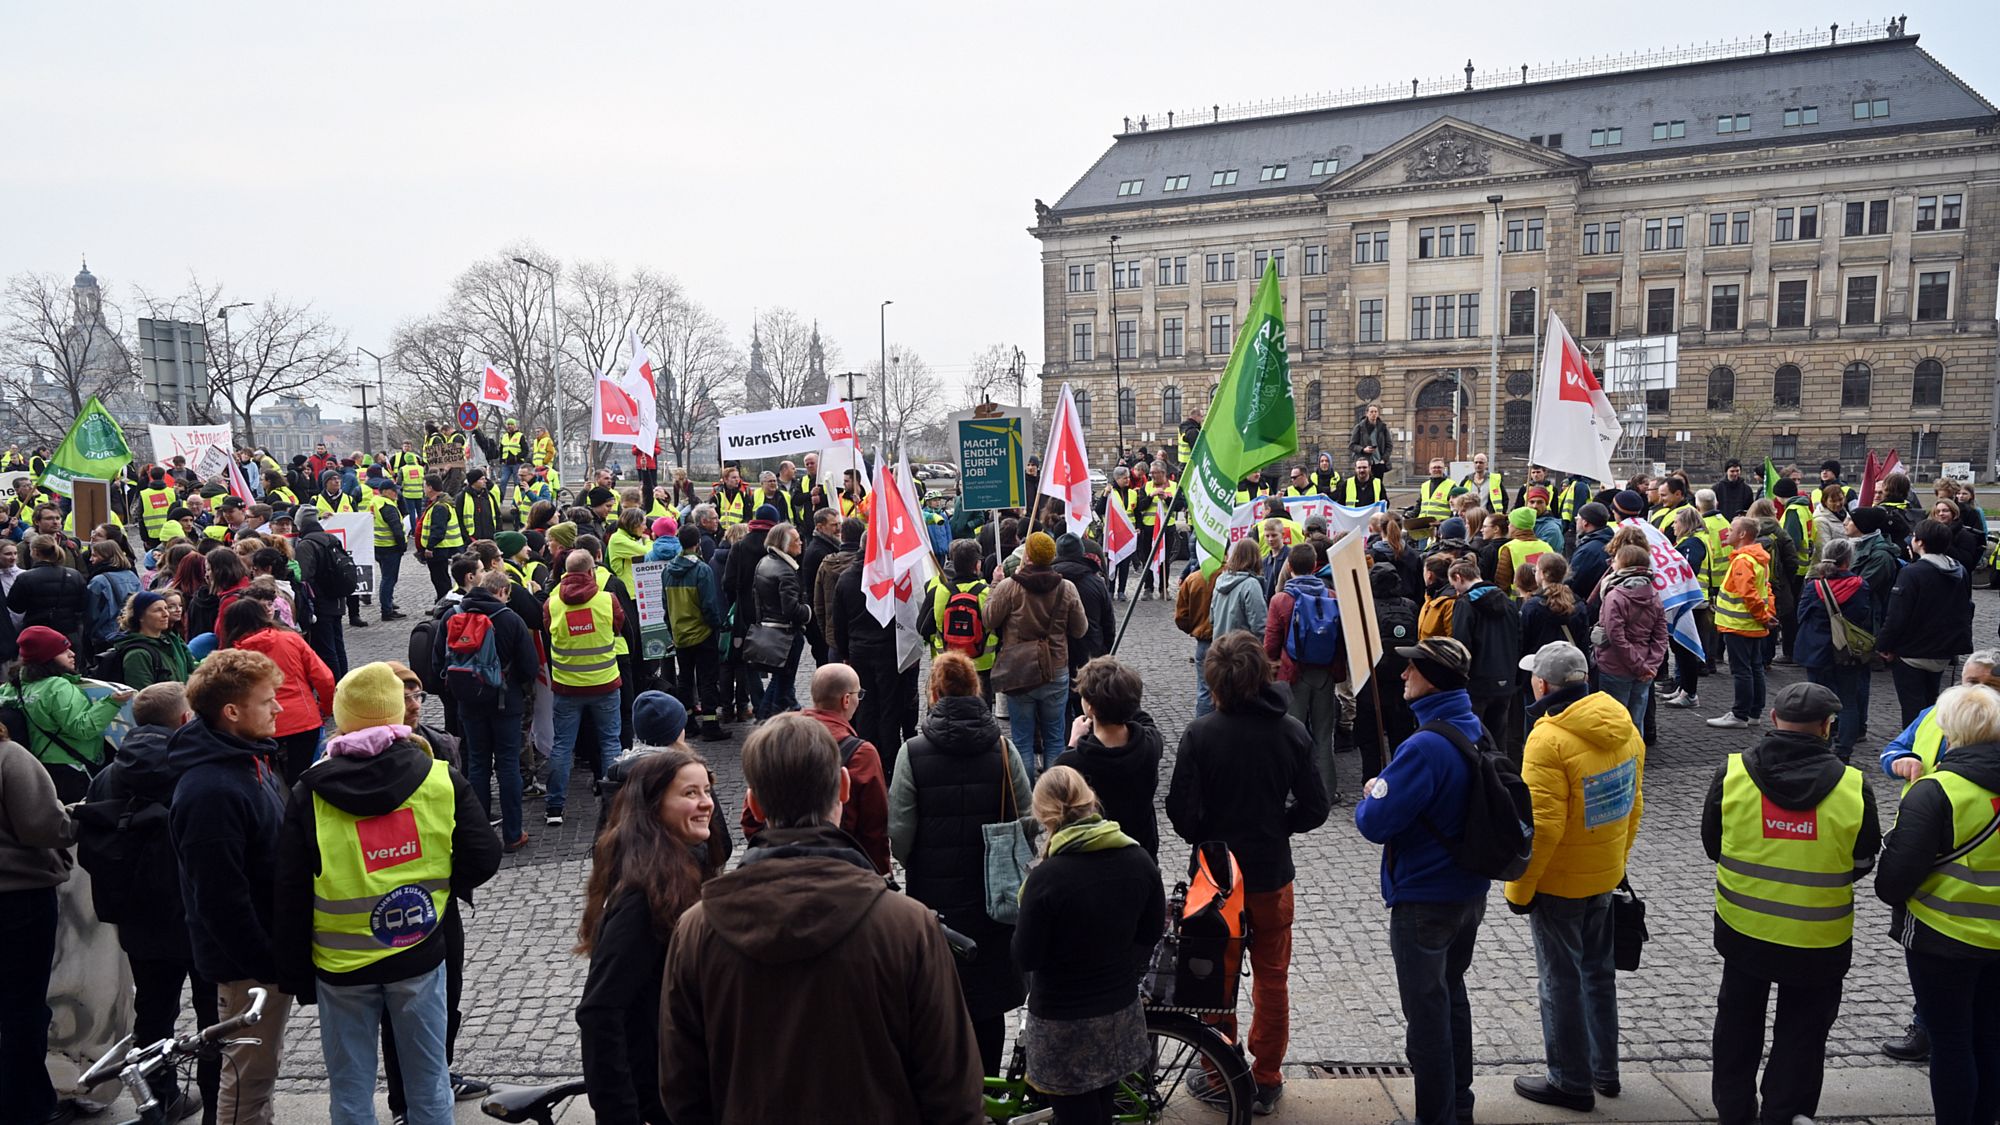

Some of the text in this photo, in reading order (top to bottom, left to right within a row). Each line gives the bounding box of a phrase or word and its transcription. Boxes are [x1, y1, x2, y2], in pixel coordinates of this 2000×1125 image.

[728, 424, 816, 448] Warnstreik
[963, 438, 999, 448] MACHT
[963, 447, 1007, 458] ENDLICH
[964, 457, 998, 468] EUREN
[965, 467, 987, 477] JOB!
[570, 622, 593, 631] ver.di
[1765, 818, 1813, 834] ver.di
[367, 841, 417, 860] ver.di
[374, 888, 403, 916] FAHREN
[403, 887, 434, 918] ZUSAMMEN
